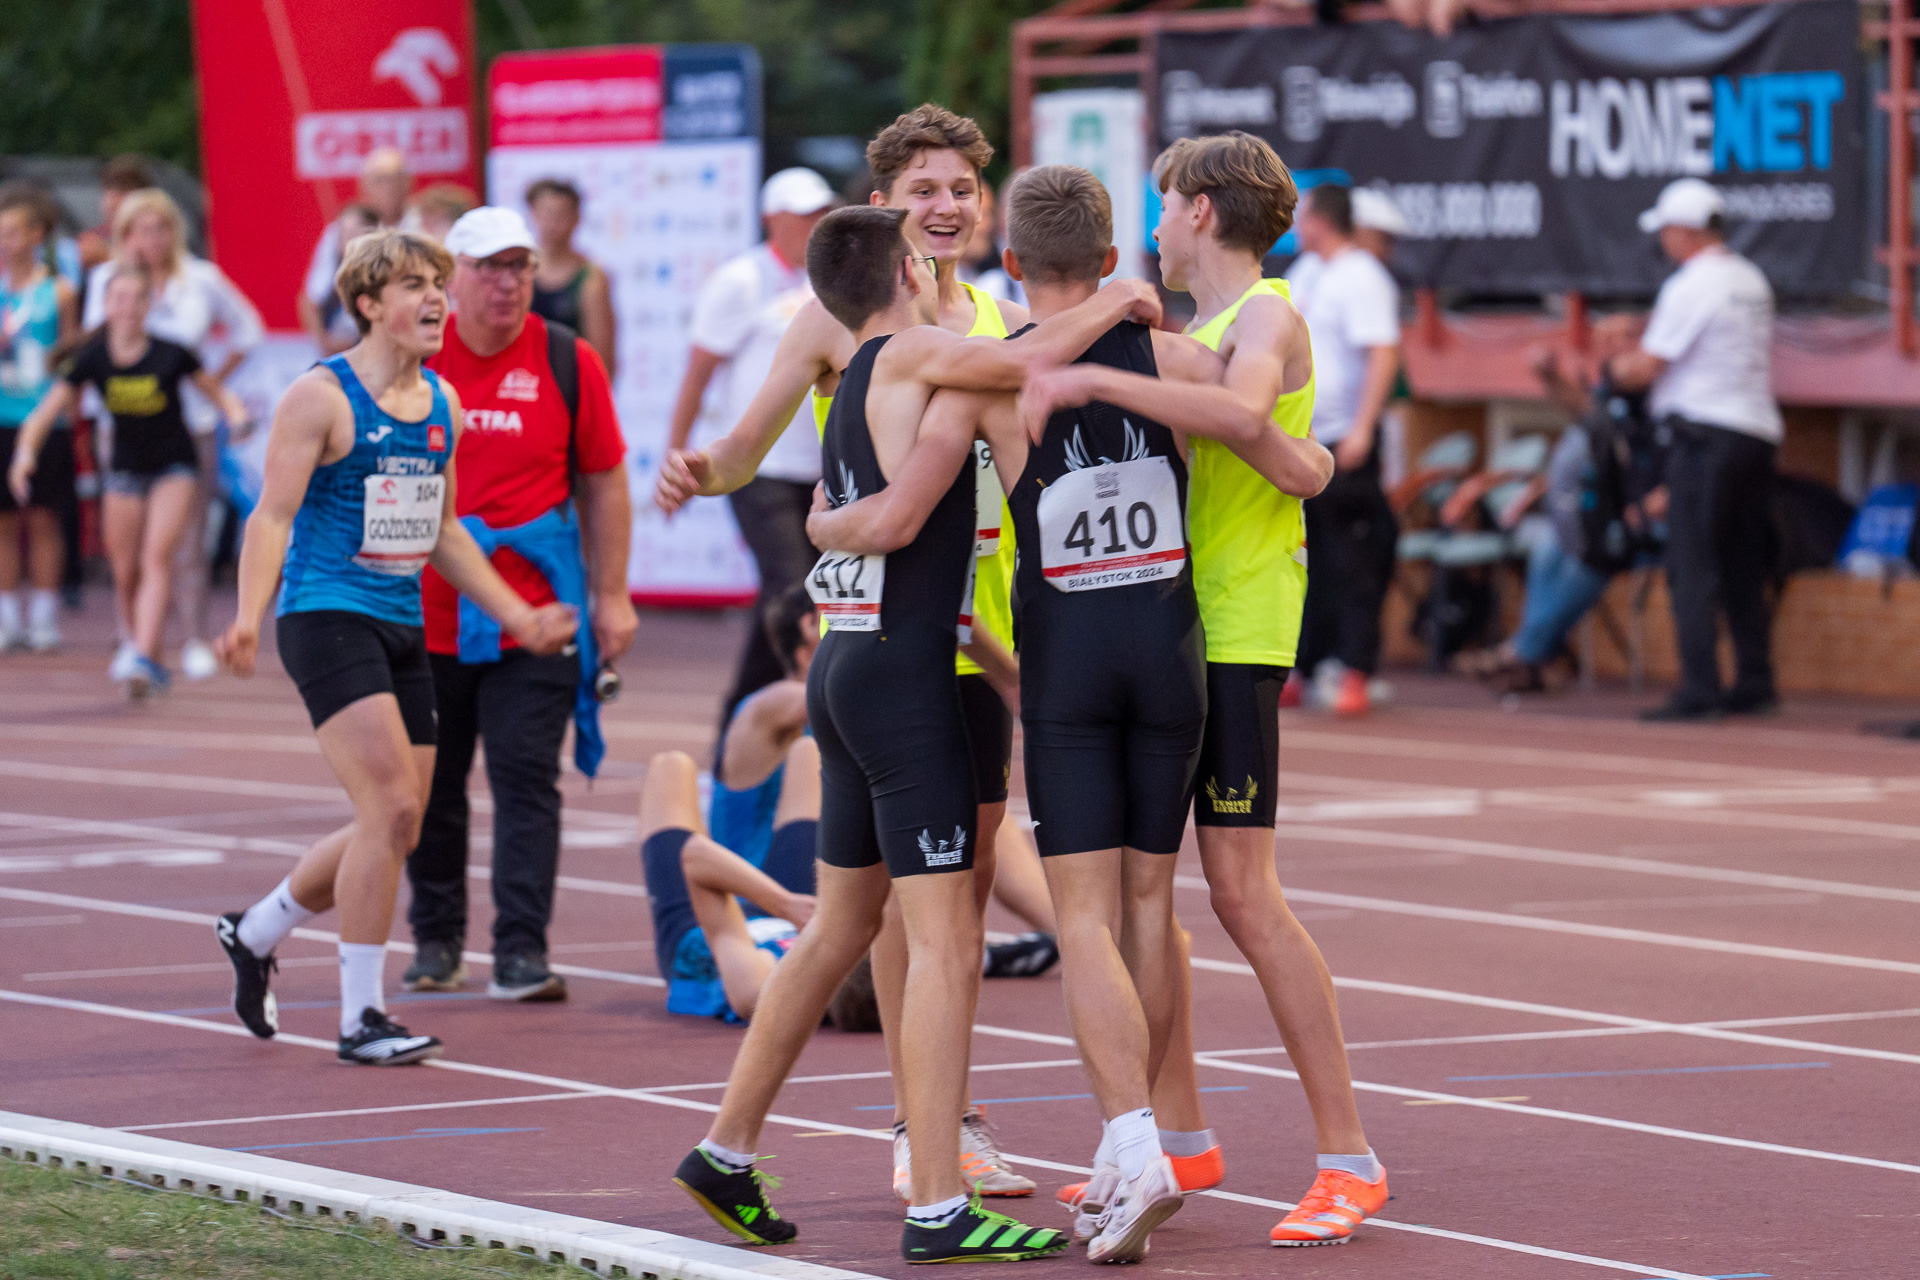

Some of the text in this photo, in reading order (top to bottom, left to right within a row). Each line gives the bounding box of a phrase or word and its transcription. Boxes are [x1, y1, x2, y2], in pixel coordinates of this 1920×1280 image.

[1551, 71, 1844, 179] HOMENET
[459, 408, 523, 432] CTRA
[377, 456, 436, 474] VECTRA
[1064, 501, 1157, 557] 410
[814, 555, 866, 598] 412
[1068, 572, 1133, 589] BIAŁYSTOK
[1135, 566, 1164, 579] 2024
